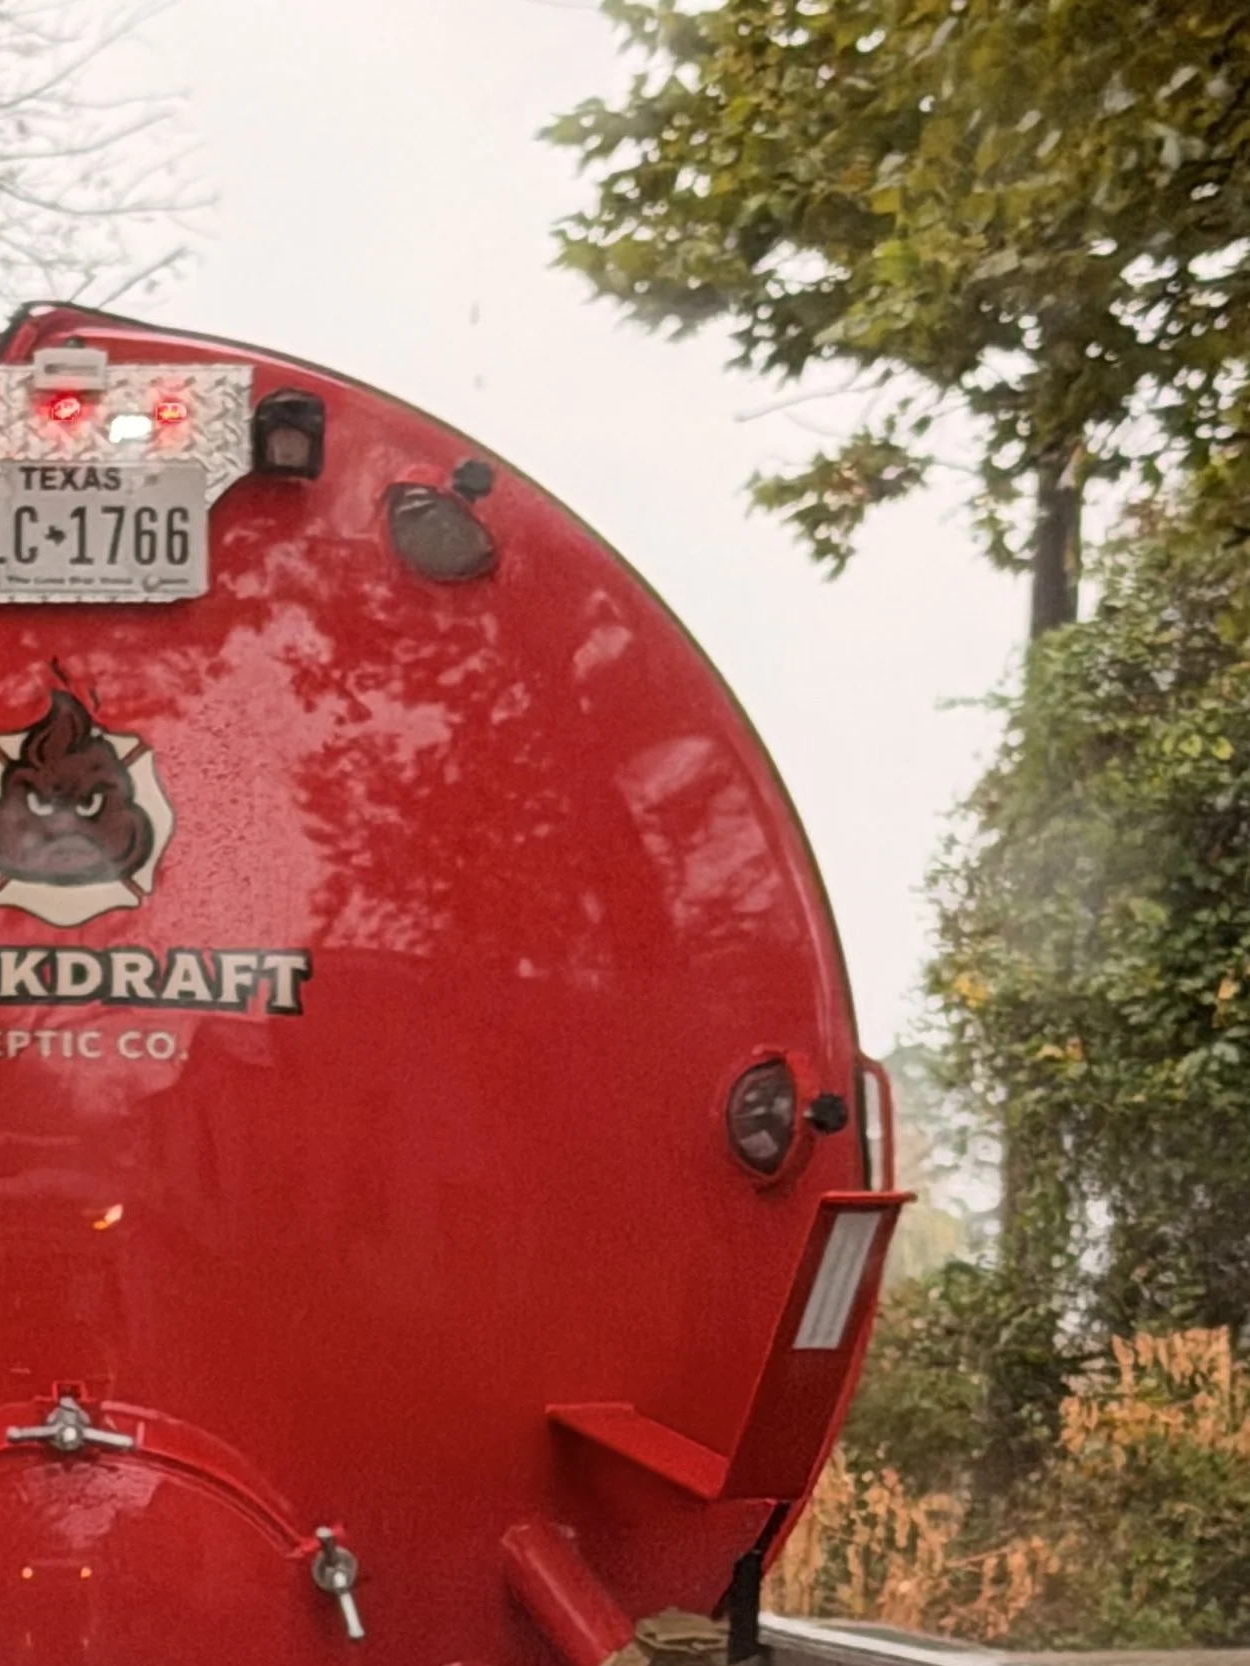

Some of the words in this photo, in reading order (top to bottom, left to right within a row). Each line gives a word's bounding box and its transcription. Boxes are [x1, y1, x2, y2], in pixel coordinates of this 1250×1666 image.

[20, 465, 121, 492] TEXAS
[69, 506, 189, 565] 1766
[118, 1031, 189, 1061] CO.
